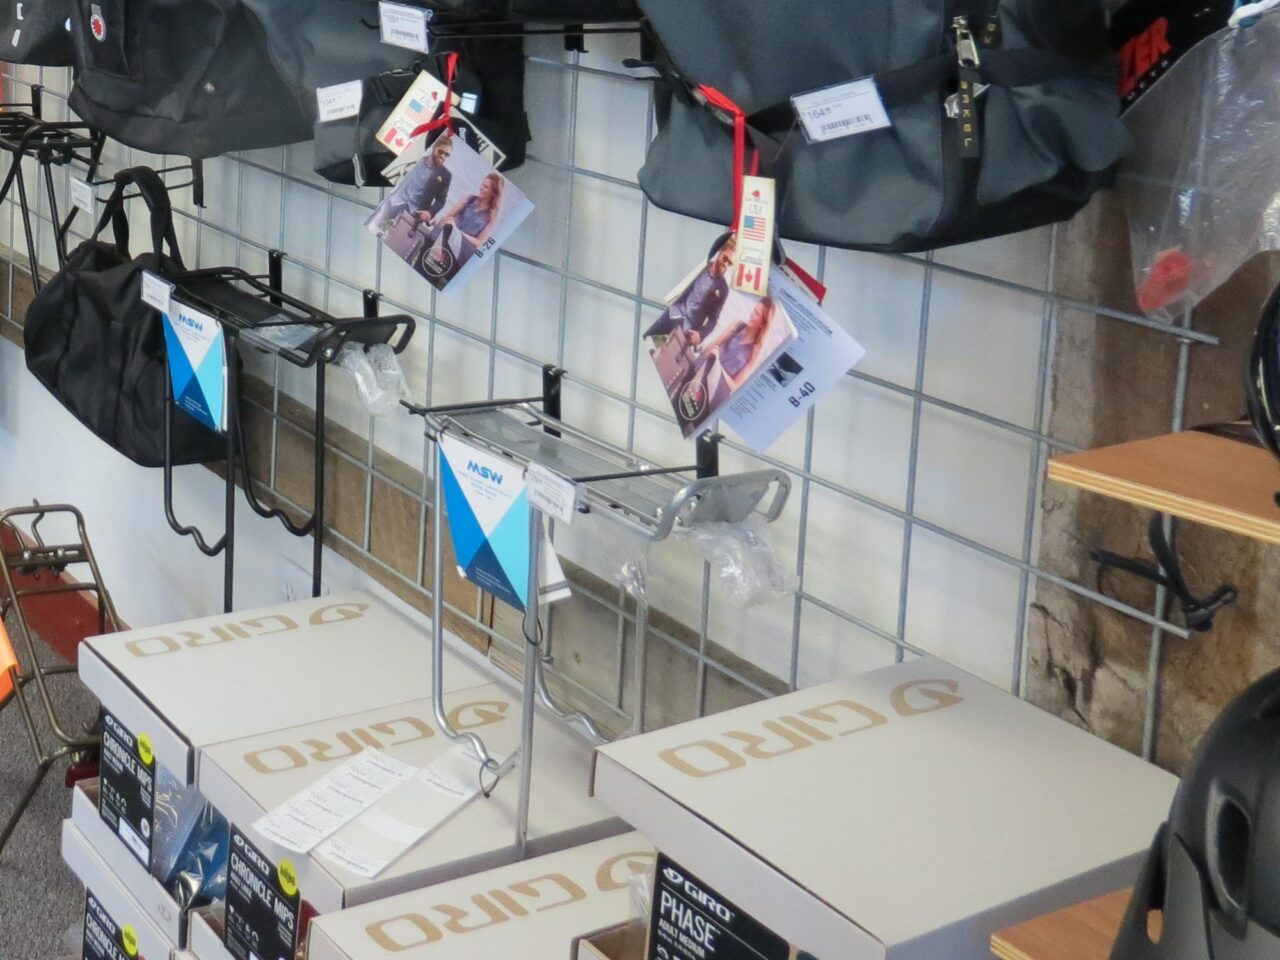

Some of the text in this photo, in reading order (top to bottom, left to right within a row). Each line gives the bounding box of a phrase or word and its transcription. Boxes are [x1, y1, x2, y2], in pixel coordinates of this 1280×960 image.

[1117, 17, 1171, 95] ZER
[474, 235, 496, 259] B-26
[467, 460, 504, 485] MSW
[122, 613, 300, 659] GIRO
[103, 731, 137, 776] CHRONICLE
[136, 764, 153, 793] MIPS
[243, 715, 437, 775] GIRO
[656, 698, 890, 780] GIRO
[244, 843, 270, 876] GIRO
[230, 852, 295, 930] CHRONICLE MIPS
[364, 870, 588, 954] GIRO
[660, 889, 716, 952] PHASE
[683, 879, 733, 923] GIRO
[658, 917, 679, 939] ADULT
[678, 930, 706, 959] MEDIUM
